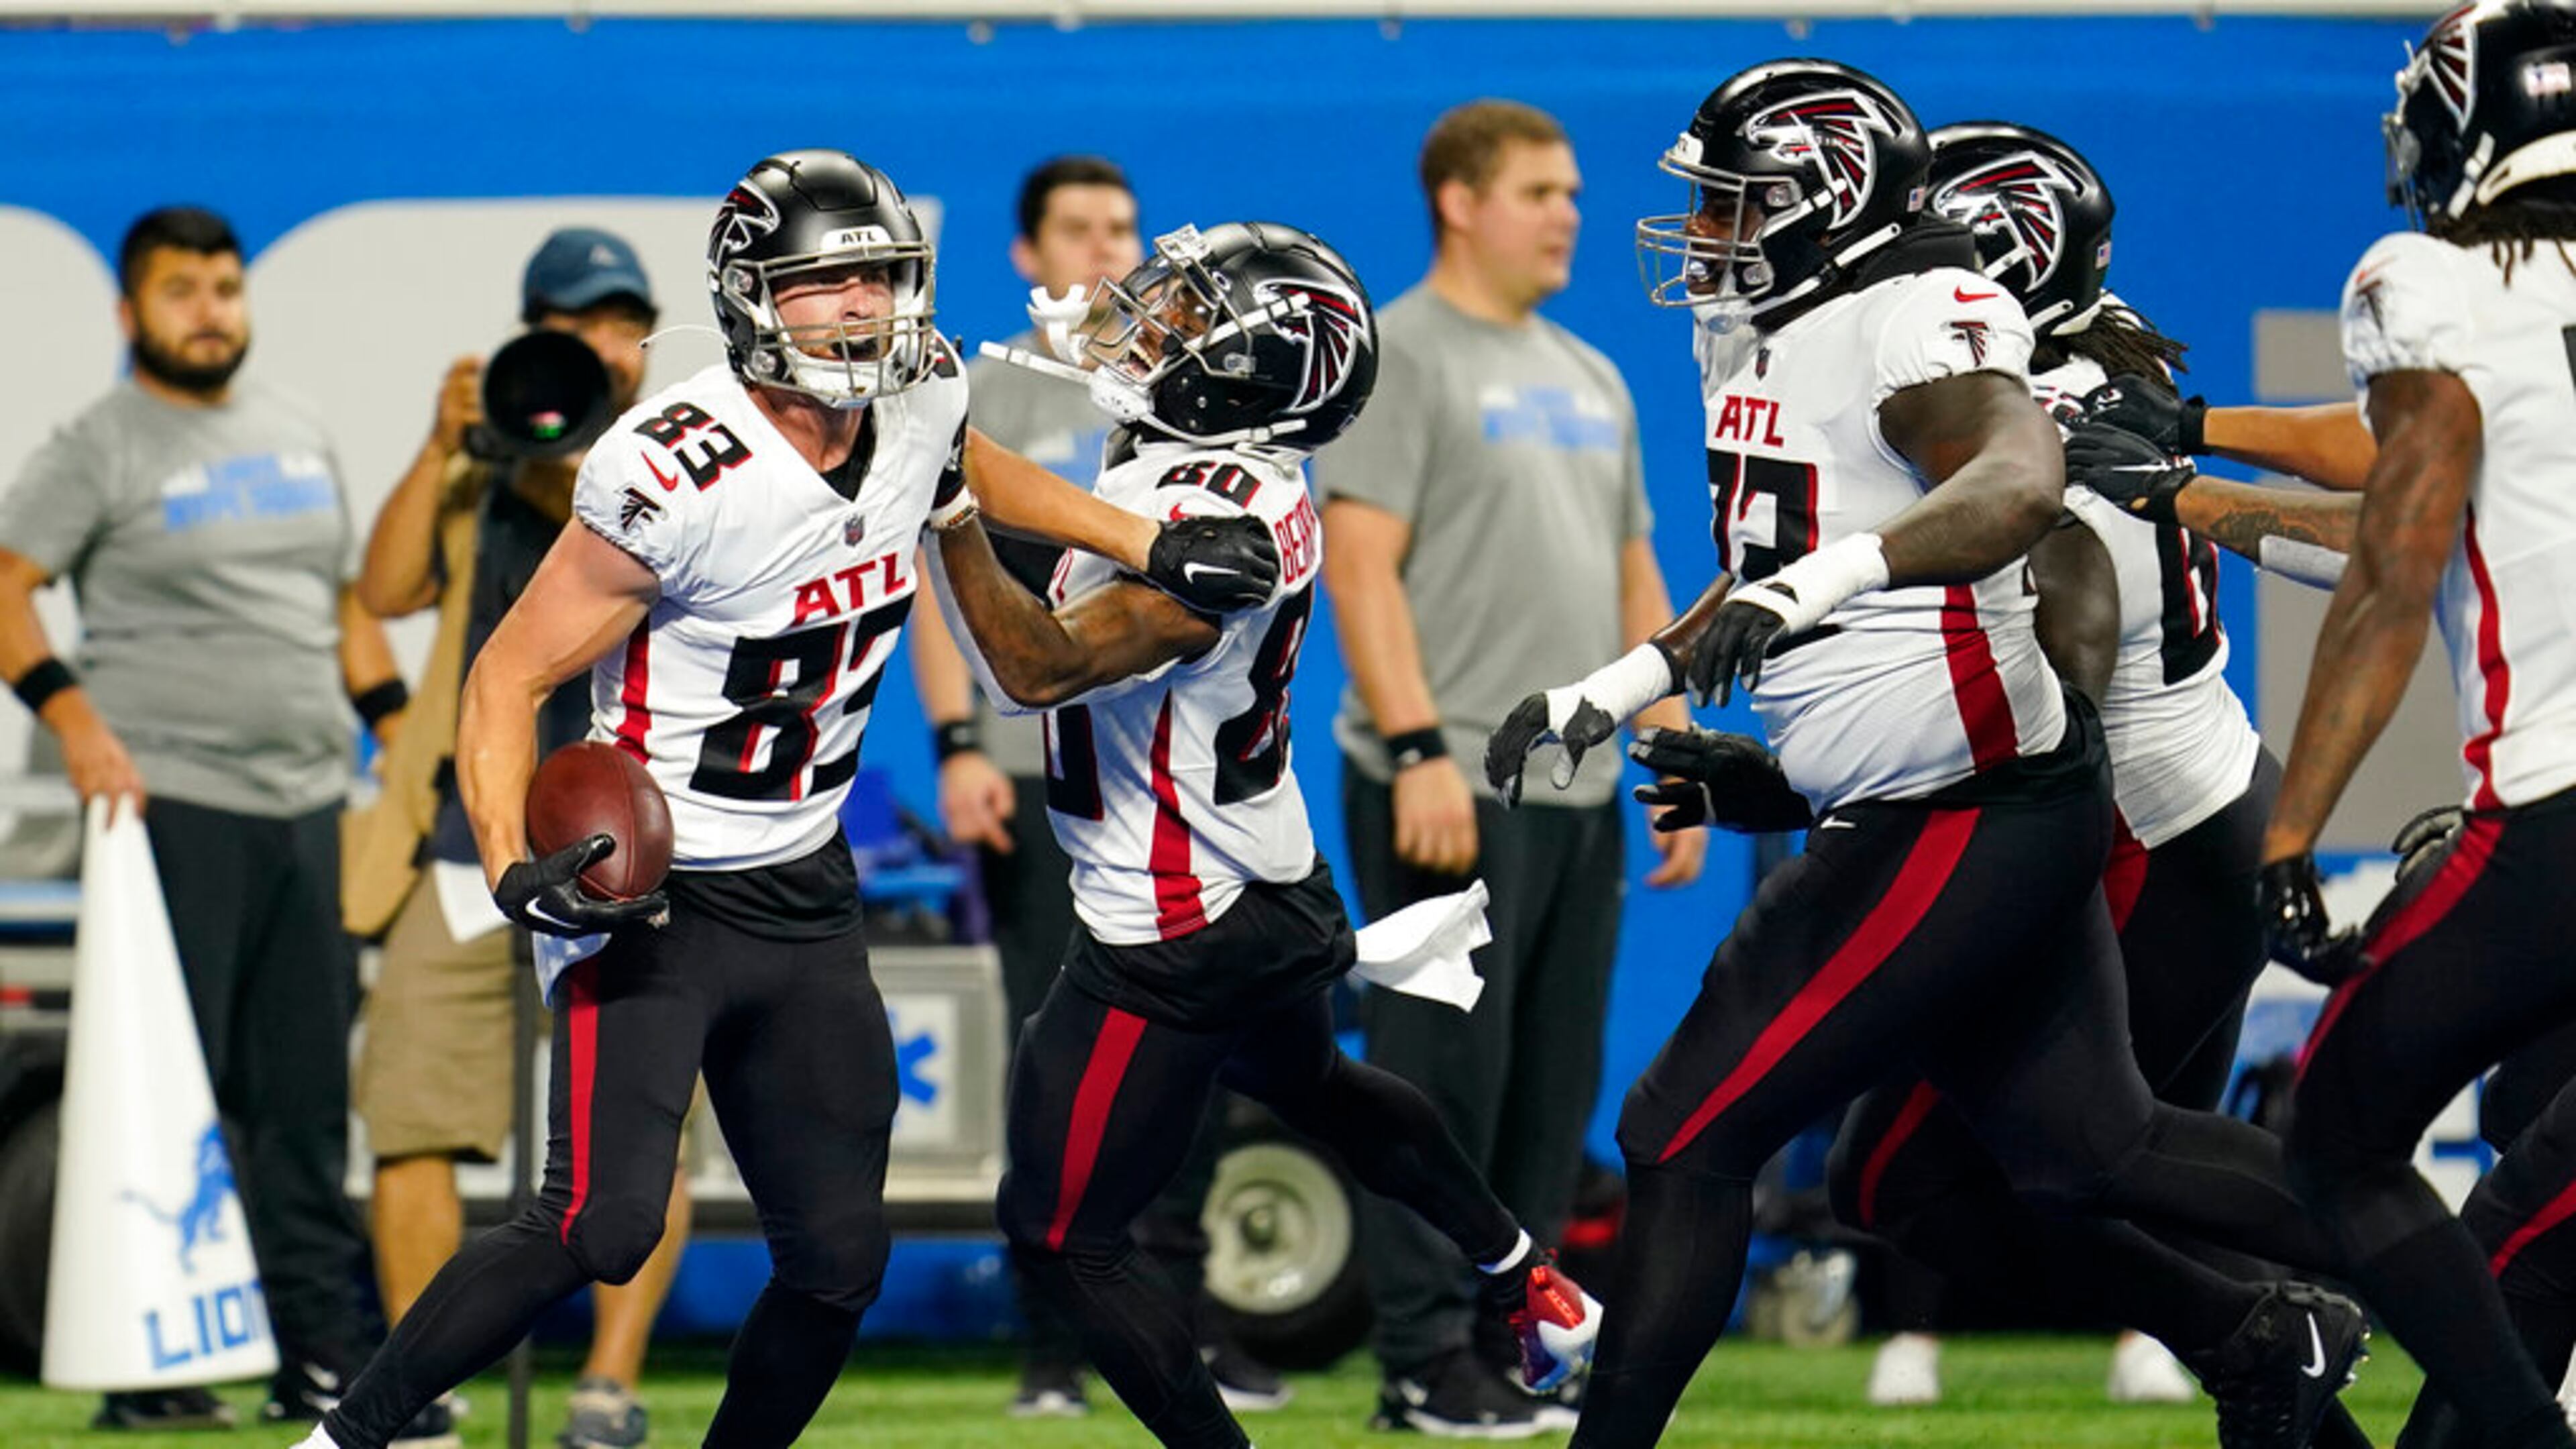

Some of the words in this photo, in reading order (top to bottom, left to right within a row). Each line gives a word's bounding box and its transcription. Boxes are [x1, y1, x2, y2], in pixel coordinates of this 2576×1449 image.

[841, 230, 876, 244] ATL
[632, 400, 753, 492] 83
[1715, 394, 1784, 447] ATL
[790, 552, 906, 628] ATL
